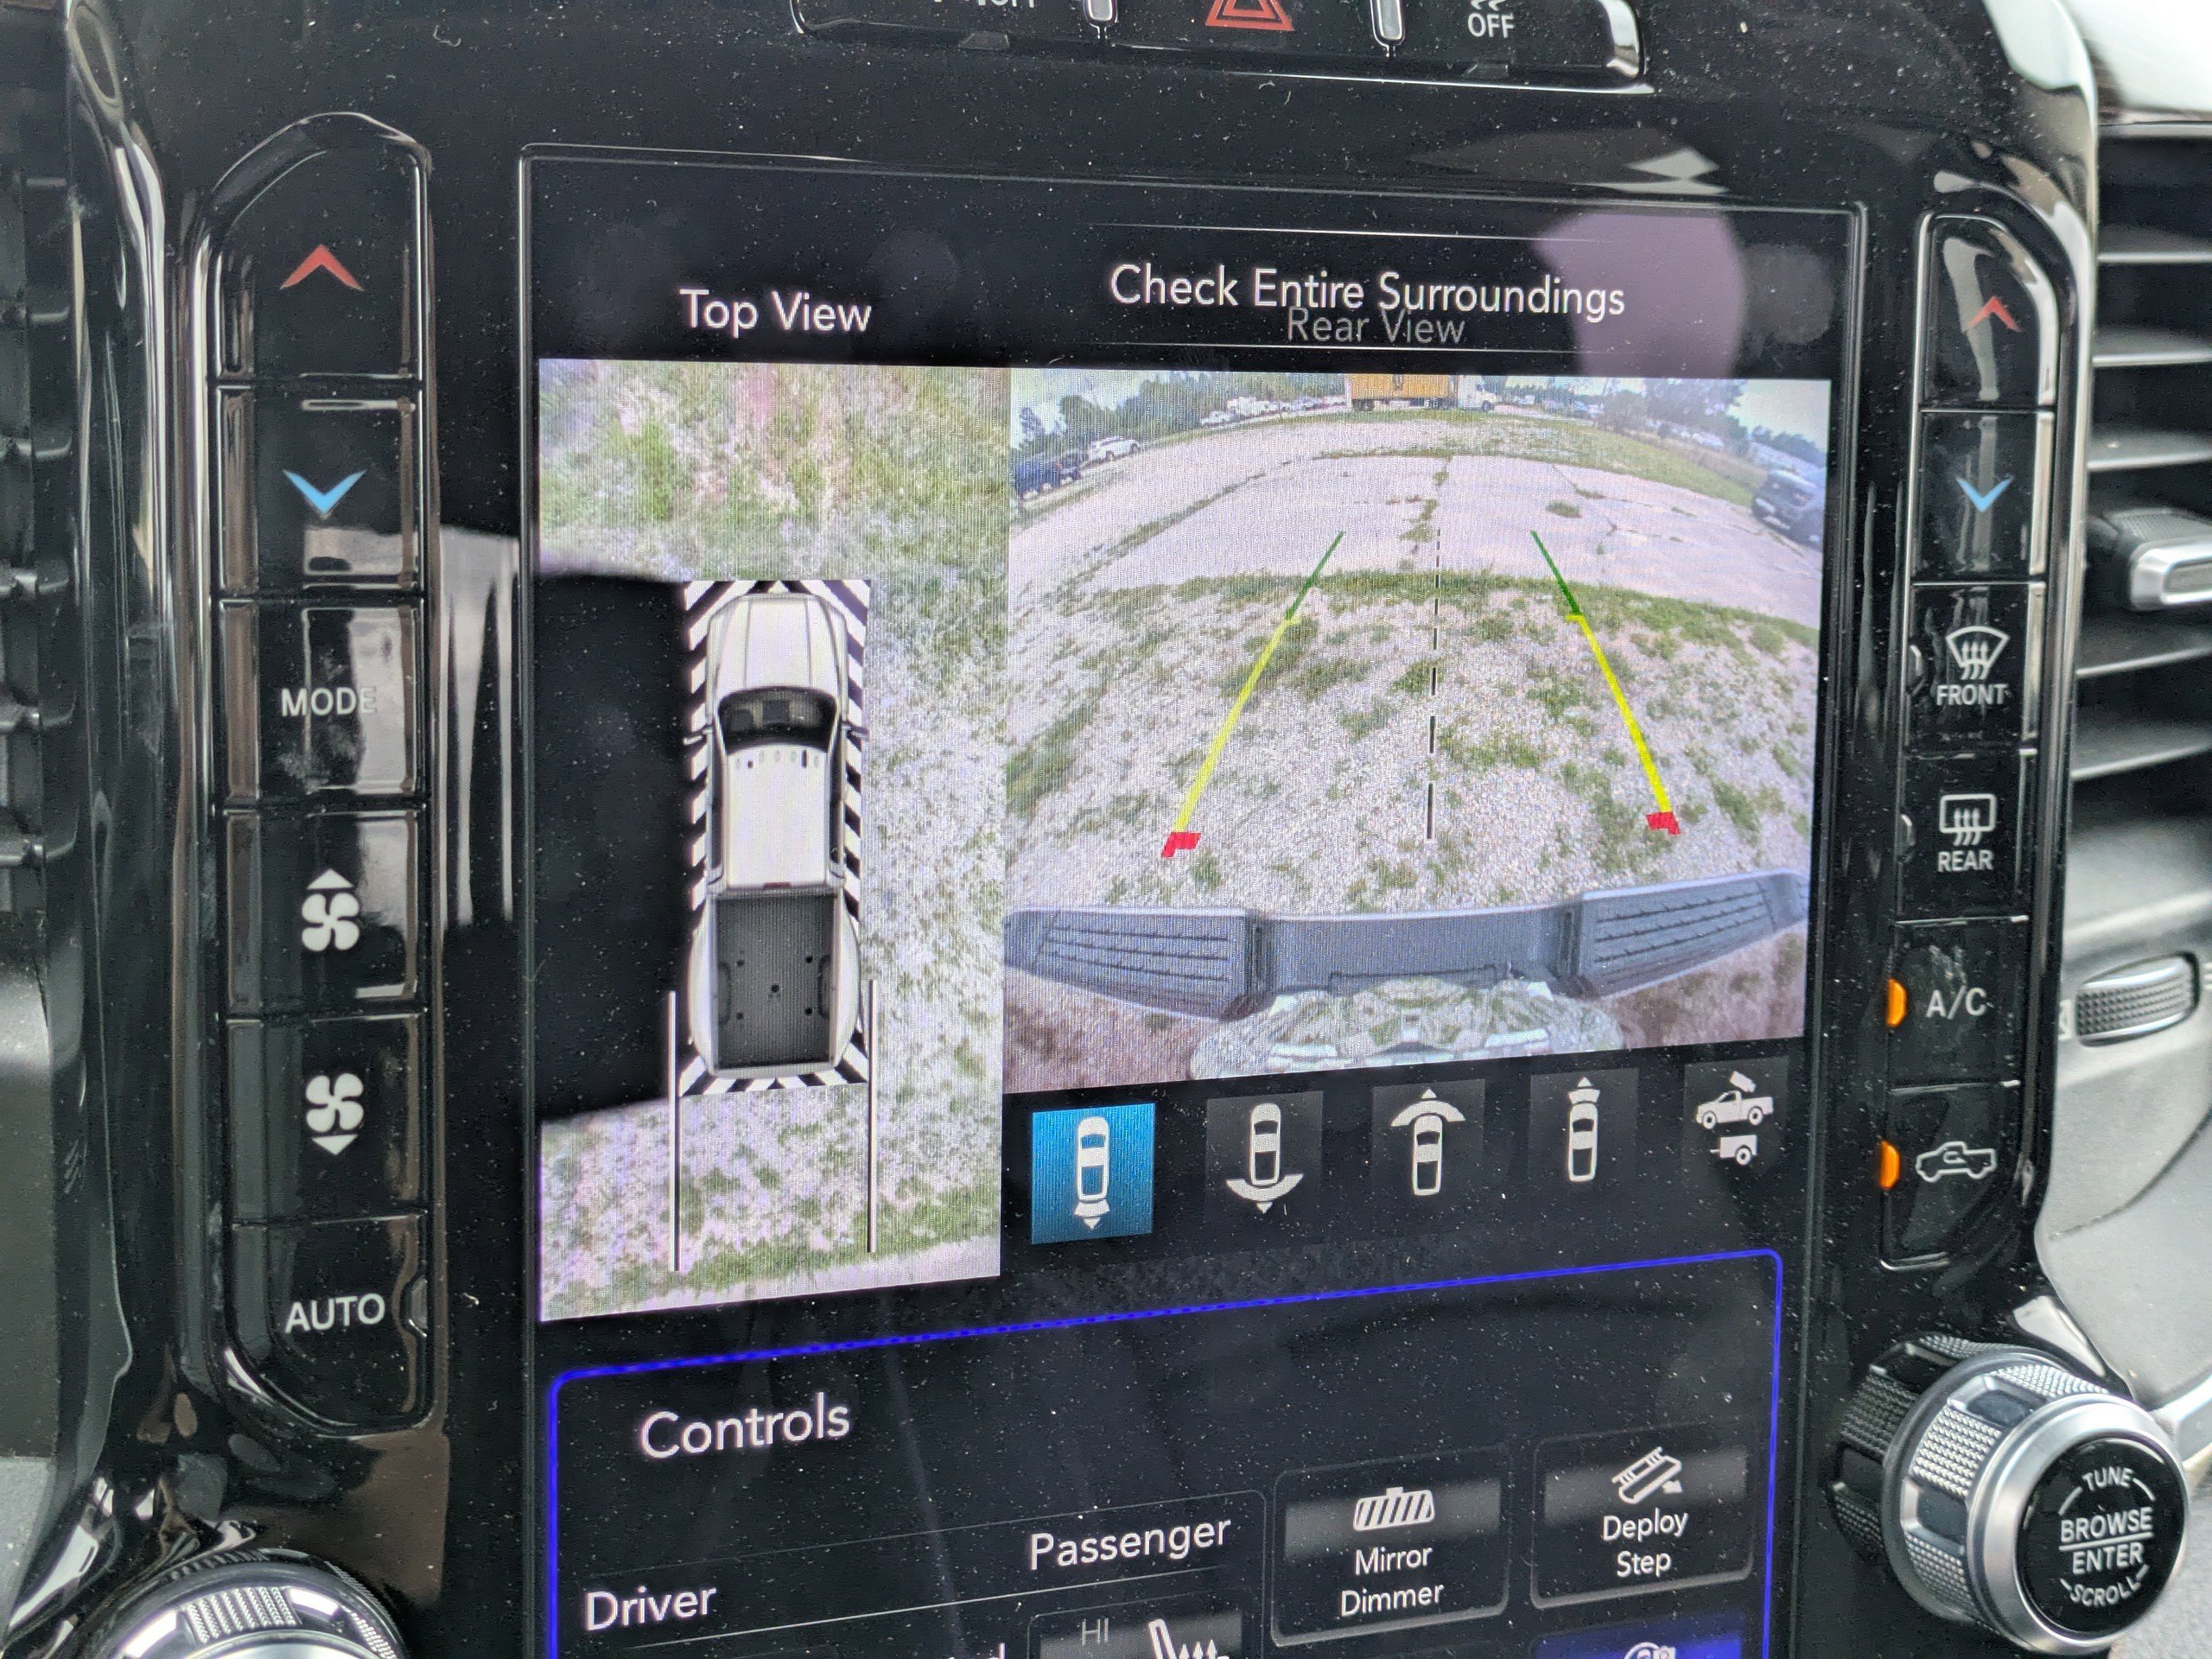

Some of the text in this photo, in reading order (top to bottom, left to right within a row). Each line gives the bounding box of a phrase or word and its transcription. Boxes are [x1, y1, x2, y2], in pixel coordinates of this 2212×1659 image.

[1467, 12, 1515, 39] OFF
[1111, 263, 1625, 323] Check Entire Surroundings
[679, 288, 873, 340] Top View
[1287, 306, 1466, 344] Rear View
[281, 687, 378, 717] MODE
[1936, 683, 2009, 707] FRONT
[1937, 849, 1994, 874] REAR
[1925, 985, 1987, 1020] A/C
[284, 1293, 386, 1333] AUTO
[639, 1391, 851, 1459] Controls
[2082, 1465, 2134, 1492] TUNE
[1602, 1509, 1689, 1543] Deploy
[2060, 1505, 2153, 1544] BROWSE
[1031, 1519, 1232, 1571] Passenger
[1354, 1546, 1433, 1577] Mirror
[2072, 1541, 2145, 1575] ENTER
[1617, 1550, 1673, 1579] Step
[586, 1585, 717, 1631] Driver
[1341, 1583, 1445, 1619] Dimmer
[2069, 1575, 2142, 1608] SCROLL
[1082, 1618, 1109, 1646] HI
